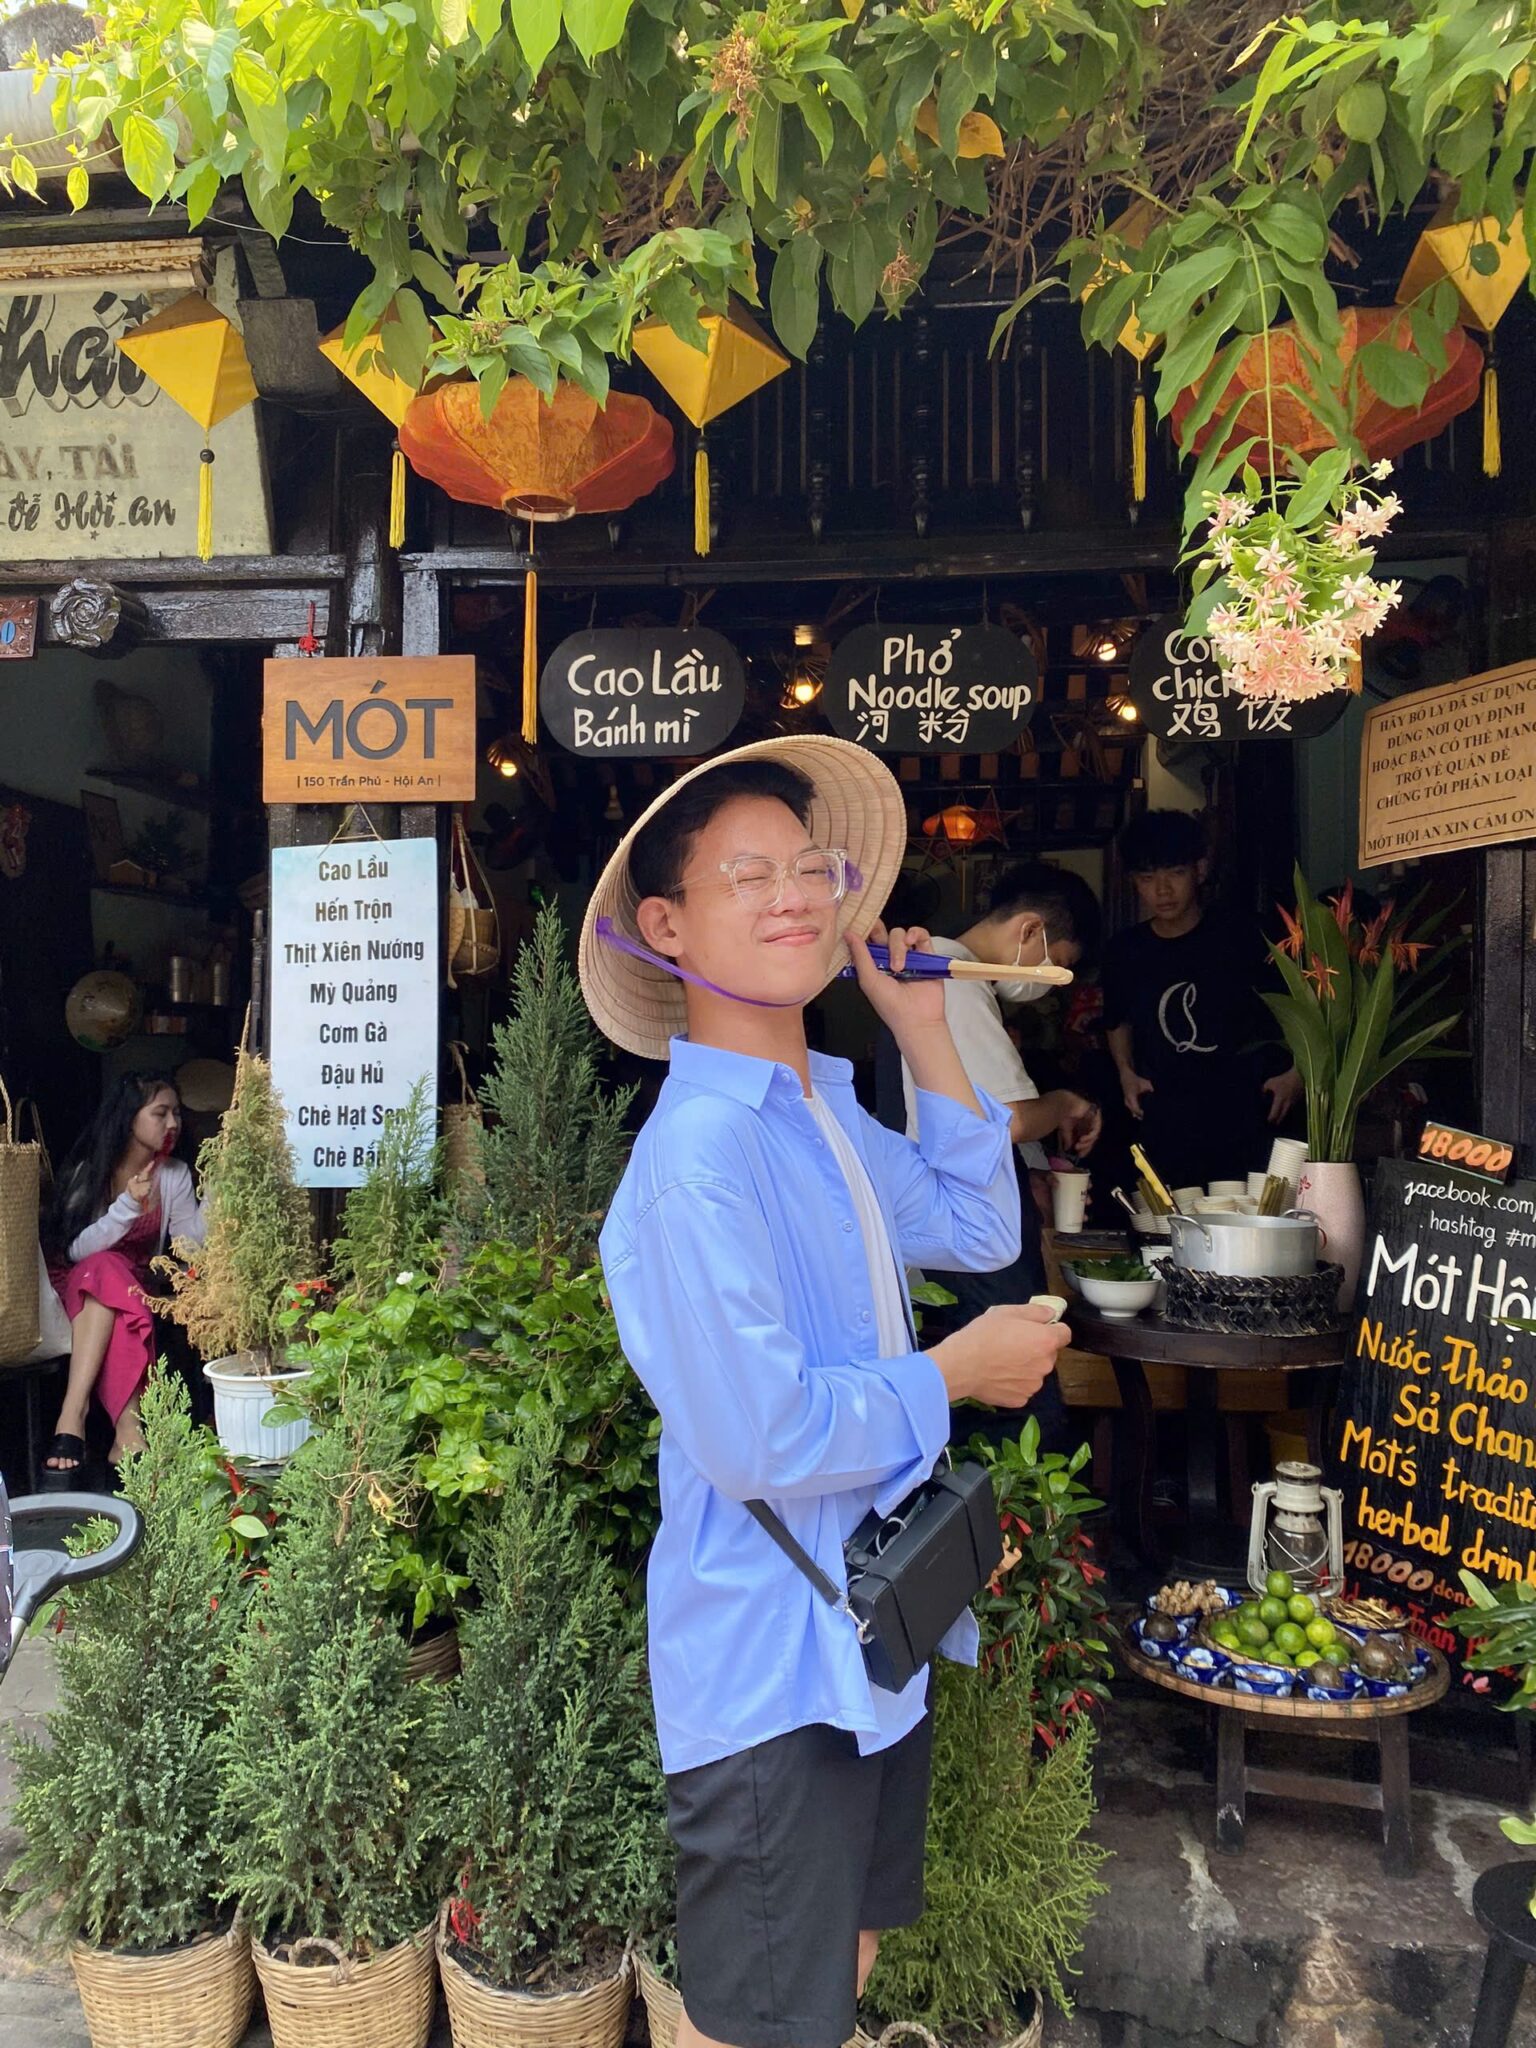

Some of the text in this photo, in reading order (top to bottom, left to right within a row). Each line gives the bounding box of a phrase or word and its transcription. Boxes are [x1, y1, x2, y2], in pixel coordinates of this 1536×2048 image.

[883, 628, 962, 676] Phở
[1164, 628, 1218, 666] Co
[567, 648, 722, 697] Cao Lầu
[848, 674, 1032, 721] Noodle soup
[1429, 702, 1448, 719] LY
[285, 679, 454, 760] MÓT
[574, 703, 700, 748] Bánh mì
[1453, 712, 1485, 733] QUY
[303, 775, 325, 787] 150
[393, 774, 414, 788] Hội
[417, 775, 434, 786] An
[1422, 825, 1441, 840] AN
[1444, 820, 1470, 837] XIN
[318, 854, 389, 882] Cao Lầu
[315, 896, 393, 925] Hến Trộn
[284, 937, 425, 968] Thịt Xiên Nướng
[310, 978, 398, 1006] Mỳ Quảng
[319, 1021, 388, 1044] Cơm Gà
[321, 1060, 384, 1090] Đậu Hủ
[298, 1103, 331, 1127] Chè
[337, 1105, 367, 1131] Hạt
[313, 1145, 347, 1168] Chè
[1430, 1209, 1497, 1249] hashtag
[1366, 1234, 1464, 1316] Mót
[1356, 1316, 1529, 1404] Nước Thảo
[1393, 1384, 1441, 1435] Sả
[1357, 1486, 1453, 1557] herbal
[1342, 1539, 1435, 1592] 18000
